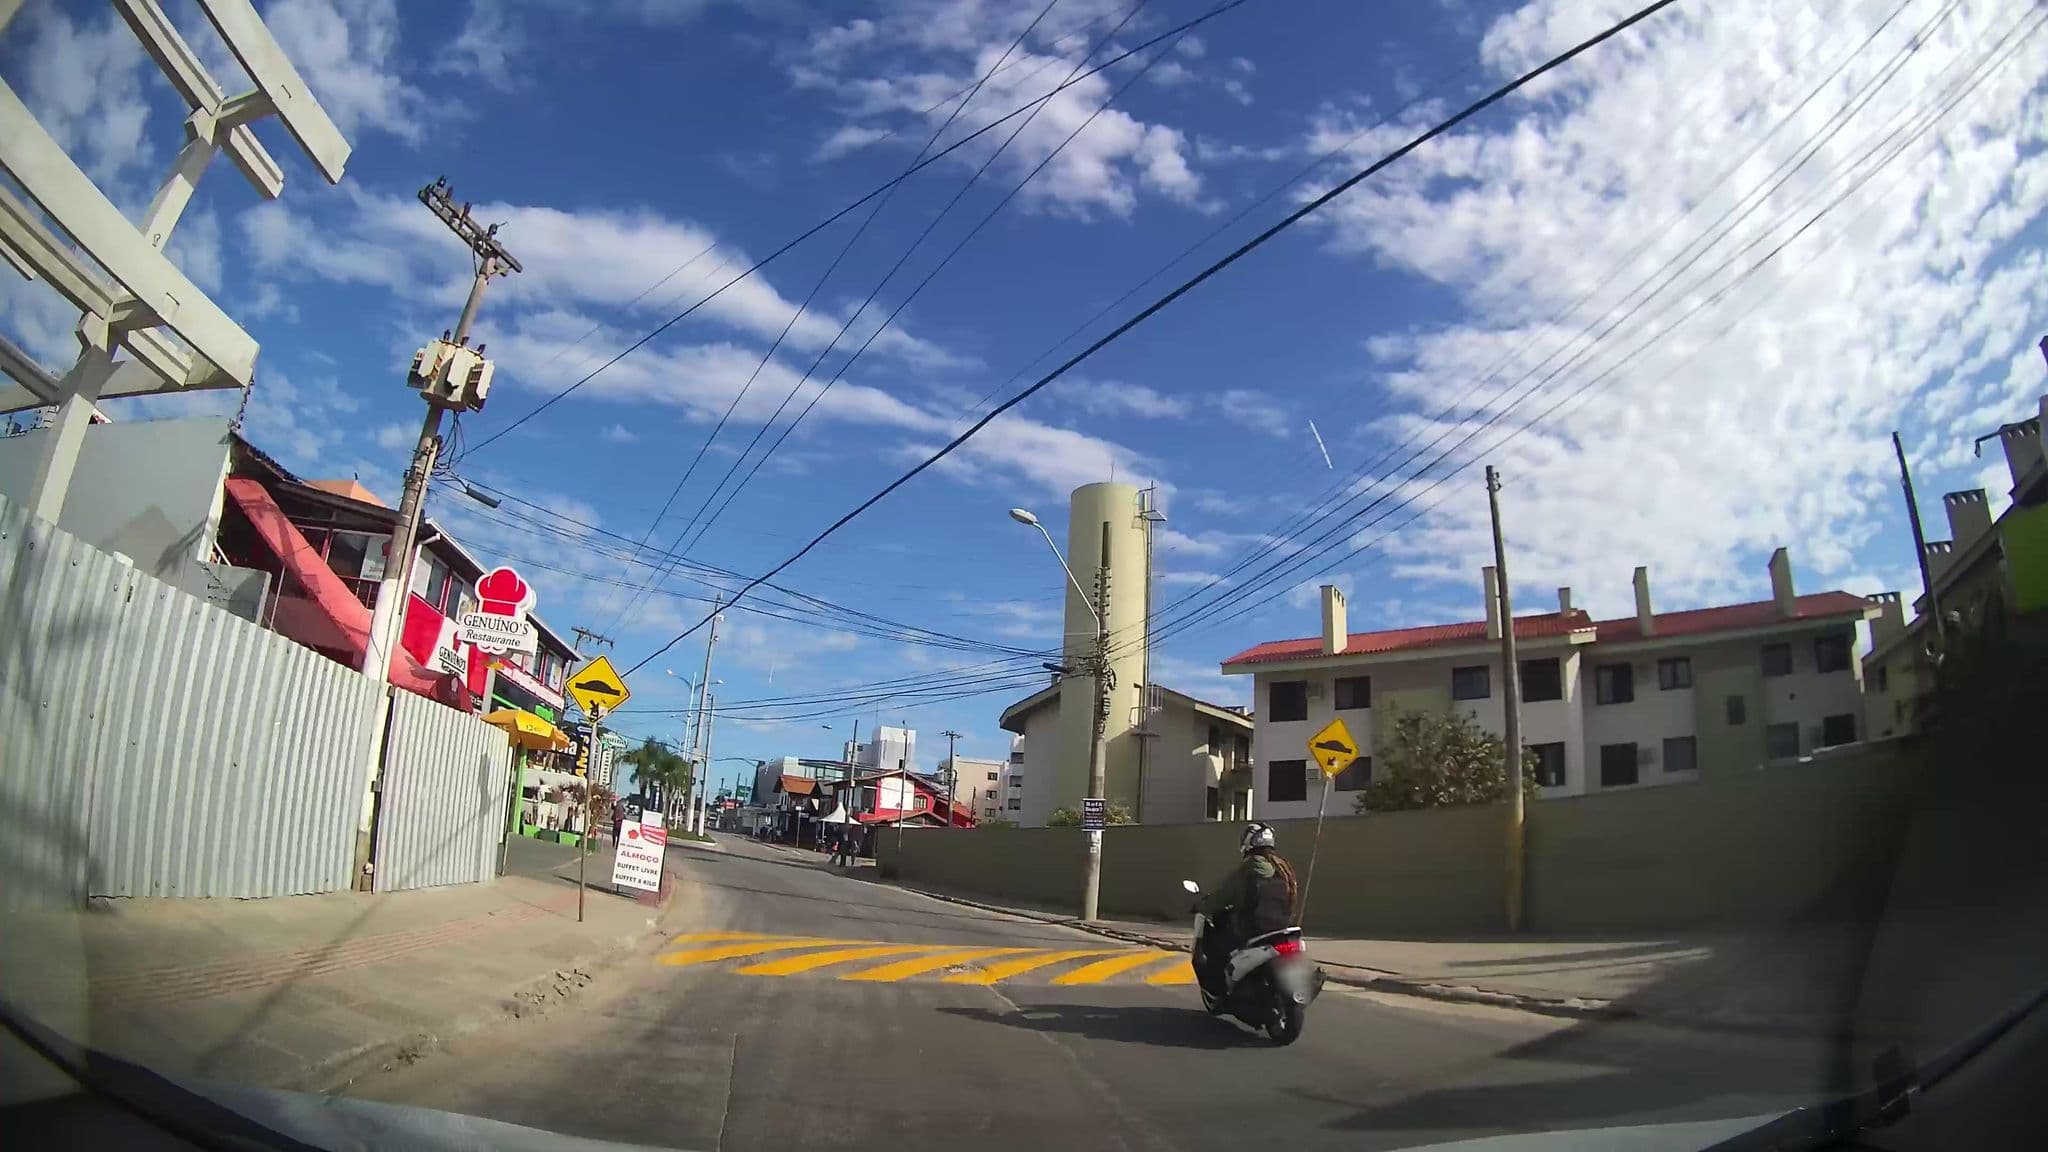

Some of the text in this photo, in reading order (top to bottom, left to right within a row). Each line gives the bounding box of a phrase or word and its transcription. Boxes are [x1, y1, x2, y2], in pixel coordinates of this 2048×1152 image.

[463, 614, 529, 635] GENUÍNO'S
[465, 628, 521, 647] Restaurante
[620, 850, 659, 864] ALMOÇO
[617, 862, 640, 872] BUFFET
